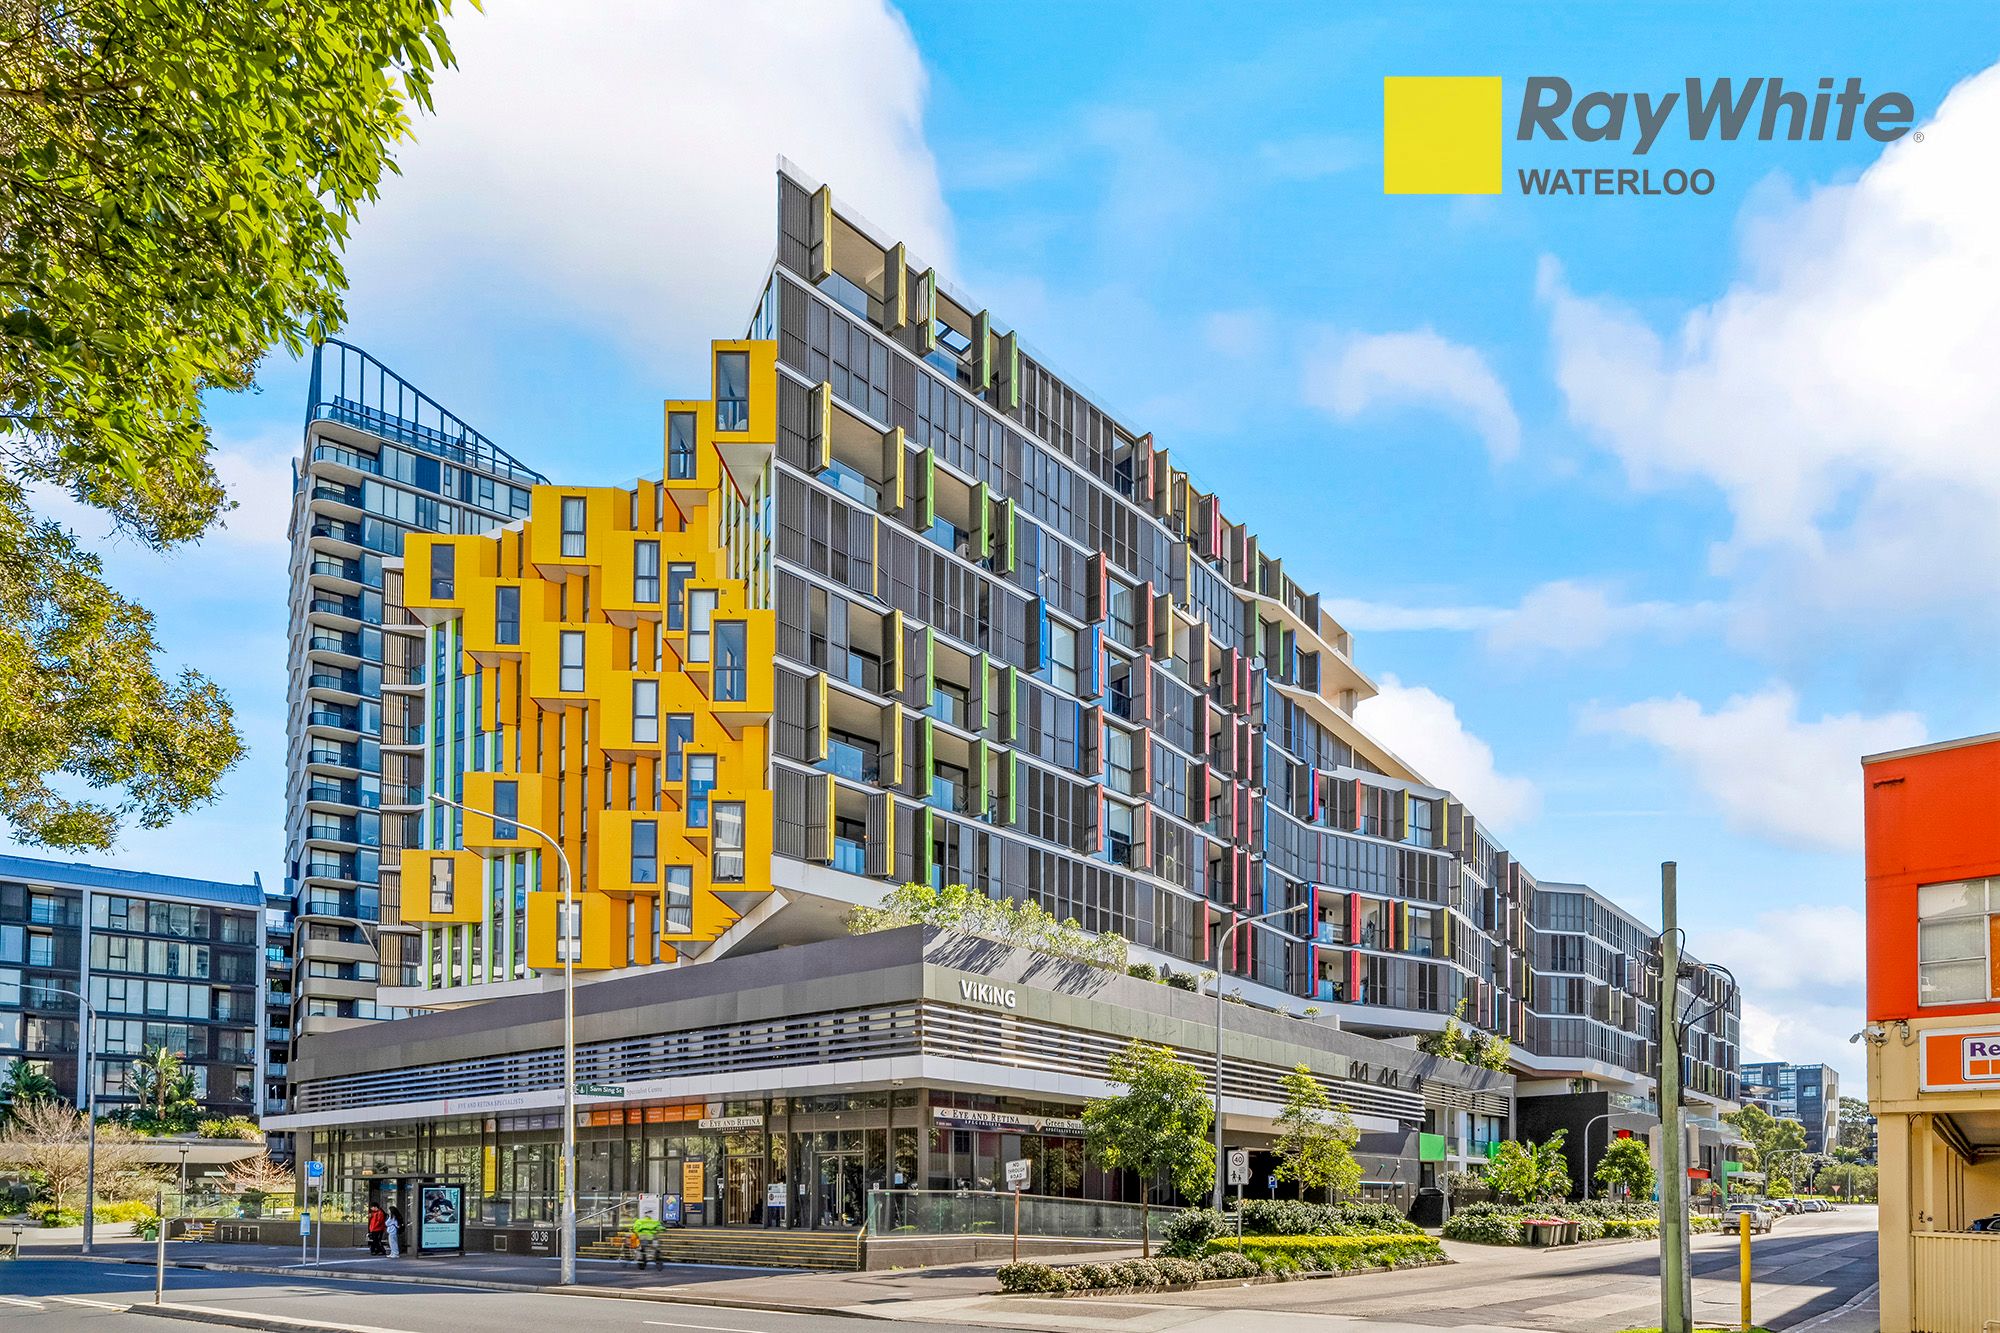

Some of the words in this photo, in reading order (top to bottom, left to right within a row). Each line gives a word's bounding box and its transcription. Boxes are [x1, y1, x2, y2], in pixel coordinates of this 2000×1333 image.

[603, 1086, 615, 1094] Sing
[1045, 1118, 1065, 1127] Green
[1066, 1120, 1086, 1129] Squar
[530, 1230, 539, 1242] 30
[540, 1231, 549, 1243] 36
